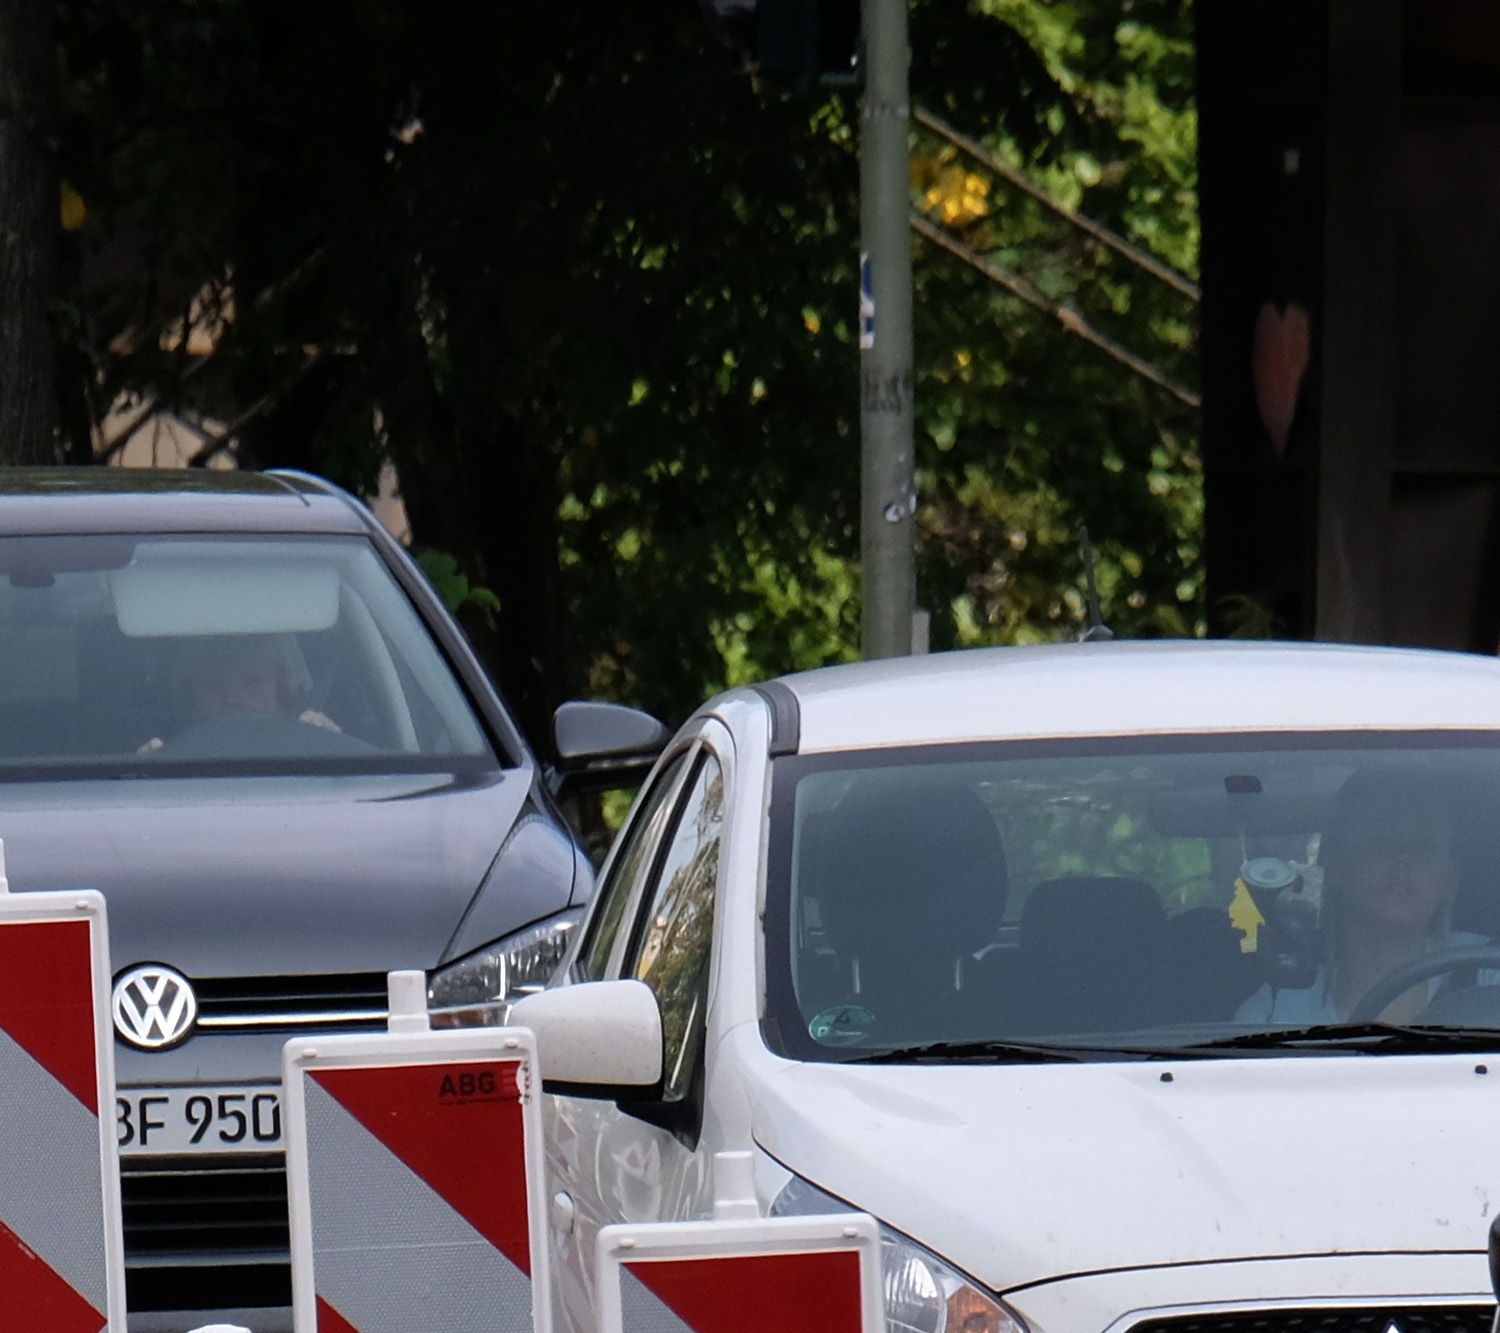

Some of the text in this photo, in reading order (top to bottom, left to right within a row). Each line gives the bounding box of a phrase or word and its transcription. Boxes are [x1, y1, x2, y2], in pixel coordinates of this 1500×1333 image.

[112, 966, 197, 1048] VW
[440, 1071, 497, 1096] ABG
[184, 1093, 282, 1144] 950
